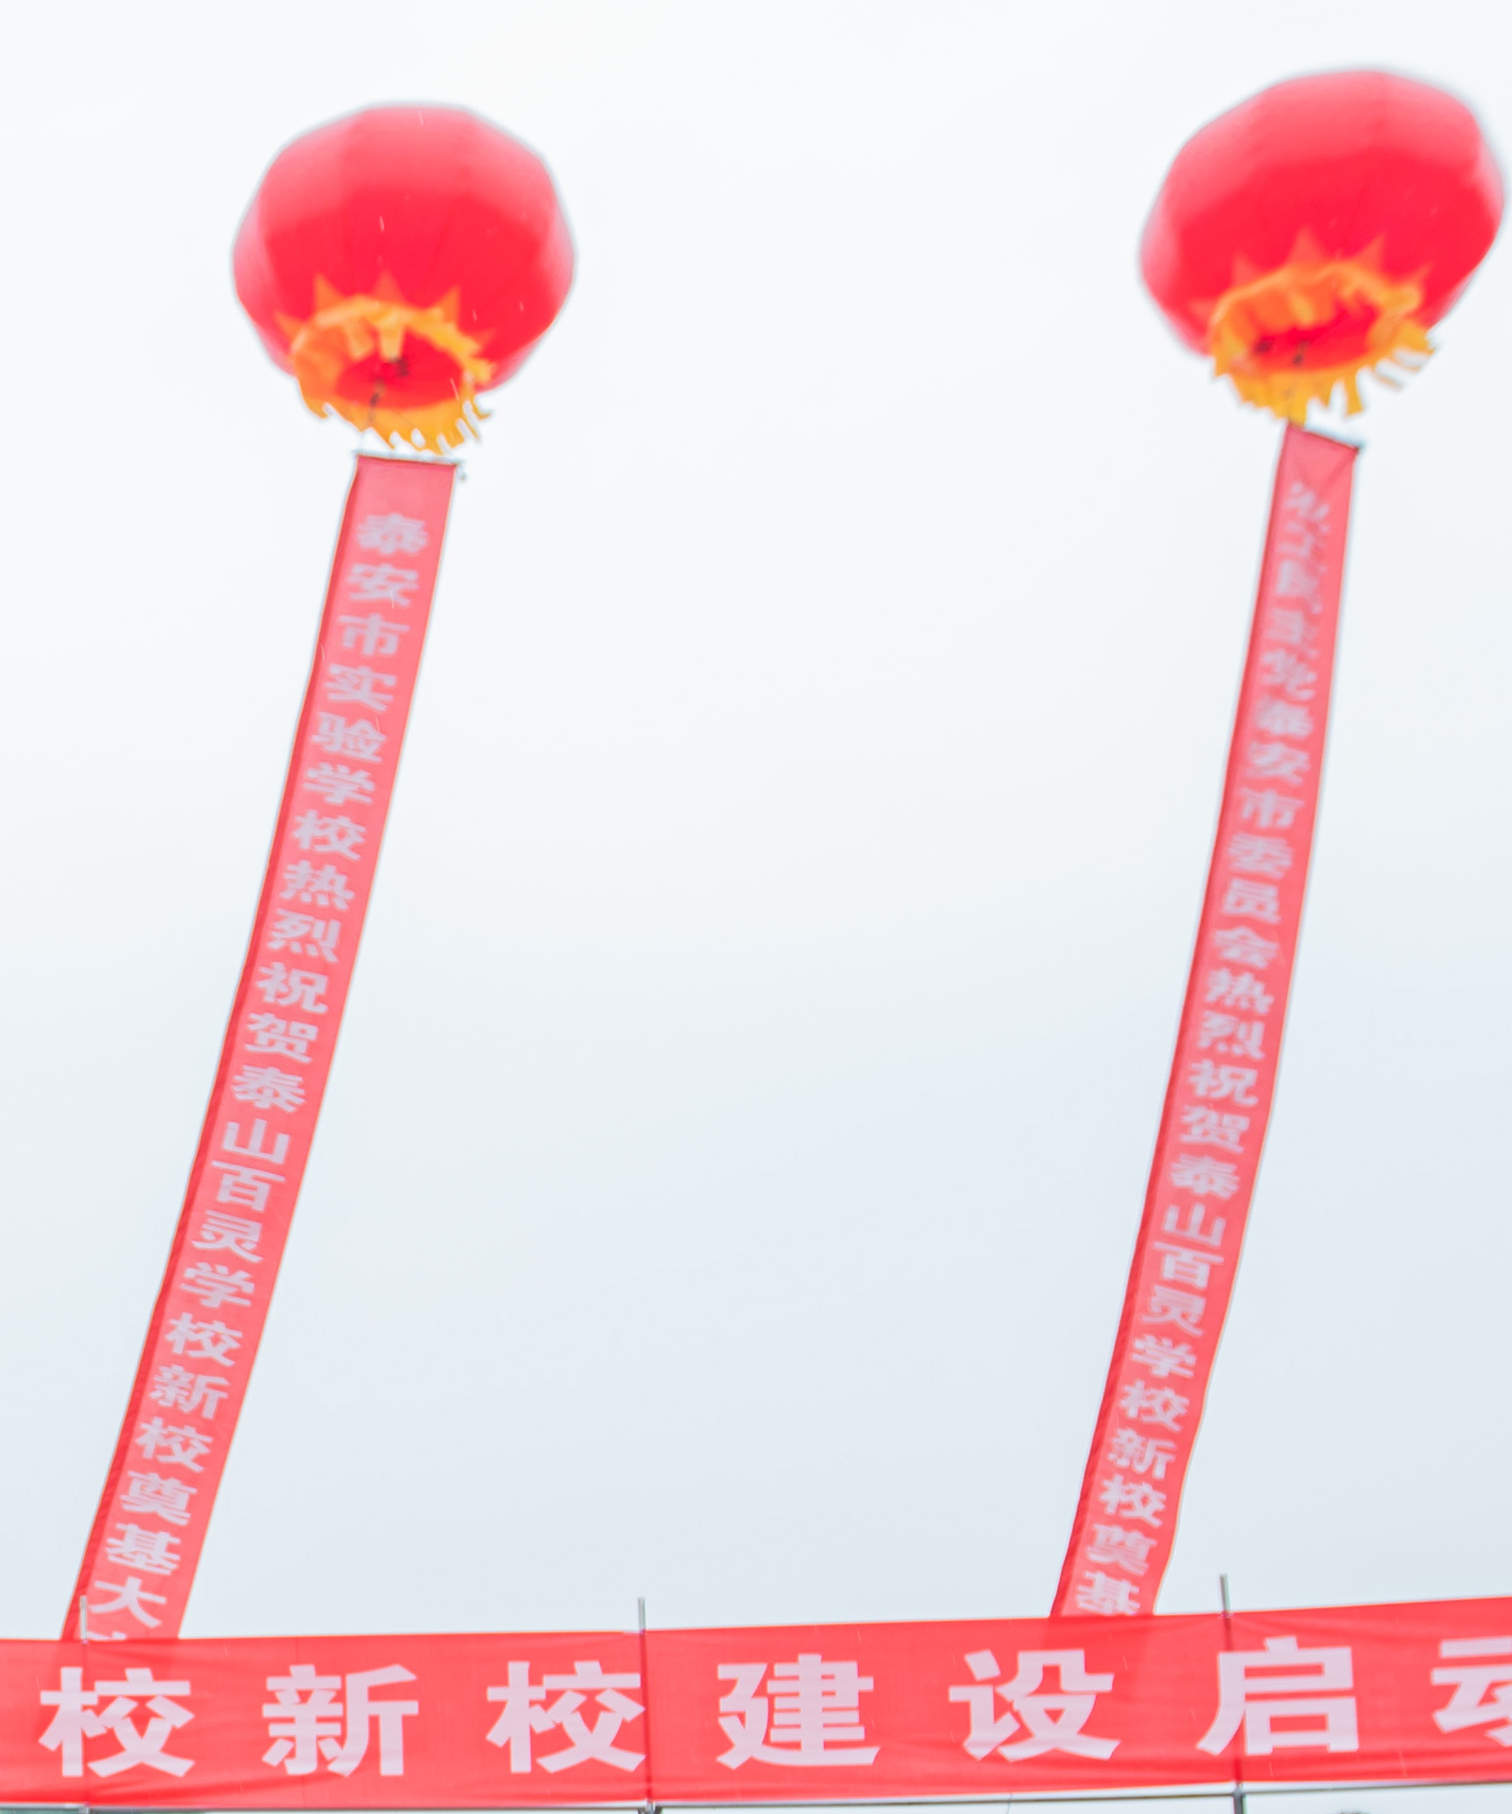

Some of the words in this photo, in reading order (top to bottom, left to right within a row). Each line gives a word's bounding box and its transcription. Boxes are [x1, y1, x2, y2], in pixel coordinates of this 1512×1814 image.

[85, 513, 429, 1640] 泰安市实验学校热烈祝贺泰山百灵学校新校奠基大
